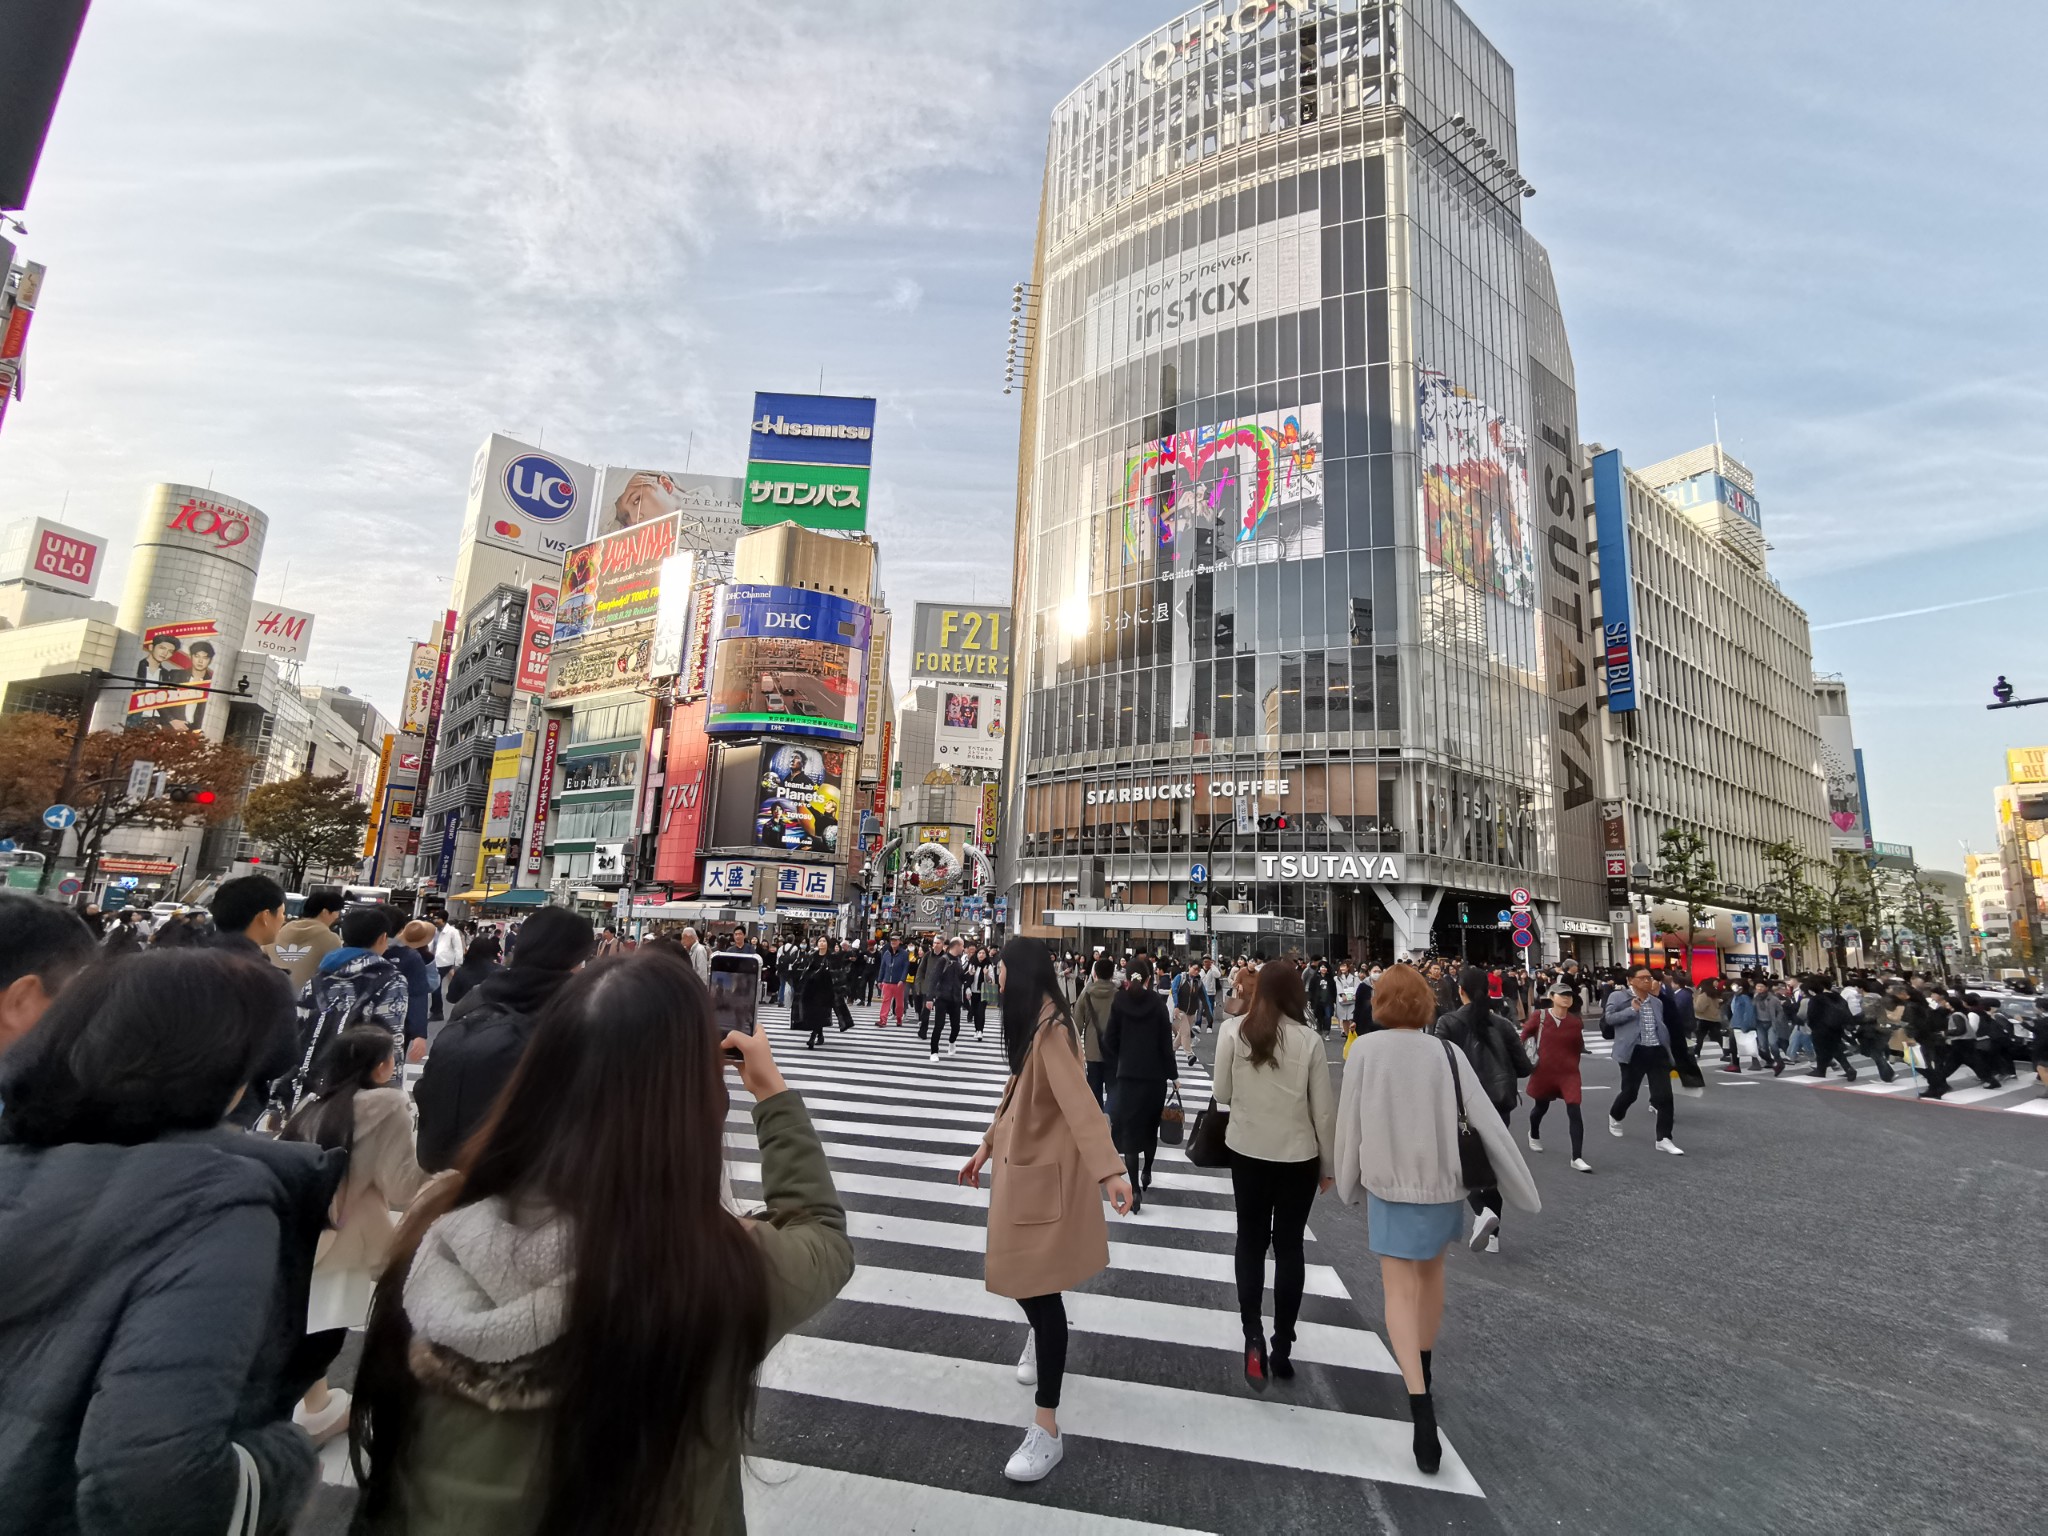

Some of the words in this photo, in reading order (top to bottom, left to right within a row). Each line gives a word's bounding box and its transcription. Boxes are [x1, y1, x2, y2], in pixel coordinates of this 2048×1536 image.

[1136, 278, 1174, 303] Now
[1180, 269, 1196, 285] or
[1200, 252, 1252, 278] never.
[1136, 277, 1250, 342] instax
[752, 414, 871, 440] Hisamitsu
[682, 497, 742, 509] TAEMIN
[749, 480, 861, 508] サロンパス
[1724, 483, 1758, 524] SEIBU
[188, 498, 250, 523] SHIBUYA
[700, 515, 740, 525] ALBUM
[166, 504, 250, 549] 109
[46, 537, 86, 560] UNI
[42, 554, 86, 578] QLO
[1161, 568, 1195, 582] Taylor
[1197, 561, 1228, 575] Swift
[741, 590, 771, 599] Channel
[254, 610, 307, 641] H&M
[764, 612, 812, 630] DHC
[1542, 423, 1593, 811] TSUTAYA
[941, 610, 1000, 651] F21
[257, 640, 286, 653] 150m
[869, 630, 885, 686] Taisei
[1606, 621, 1632, 696] SEIBU
[915, 652, 998, 674] FOREVER
[866, 689, 879, 736] neon
[2025, 749, 2046, 764] TO
[776, 787, 825, 803] Planets
[784, 781, 813, 790] teamLab
[1086, 783, 1196, 805] STARBUCKS
[1208, 779, 1290, 797] COFFEE
[786, 811, 813, 821] TOYOSU
[1261, 855, 1400, 879] TSUTAYA
[1609, 861, 1623, 874] 本
[1562, 918, 1588, 933] TSUTAYA
